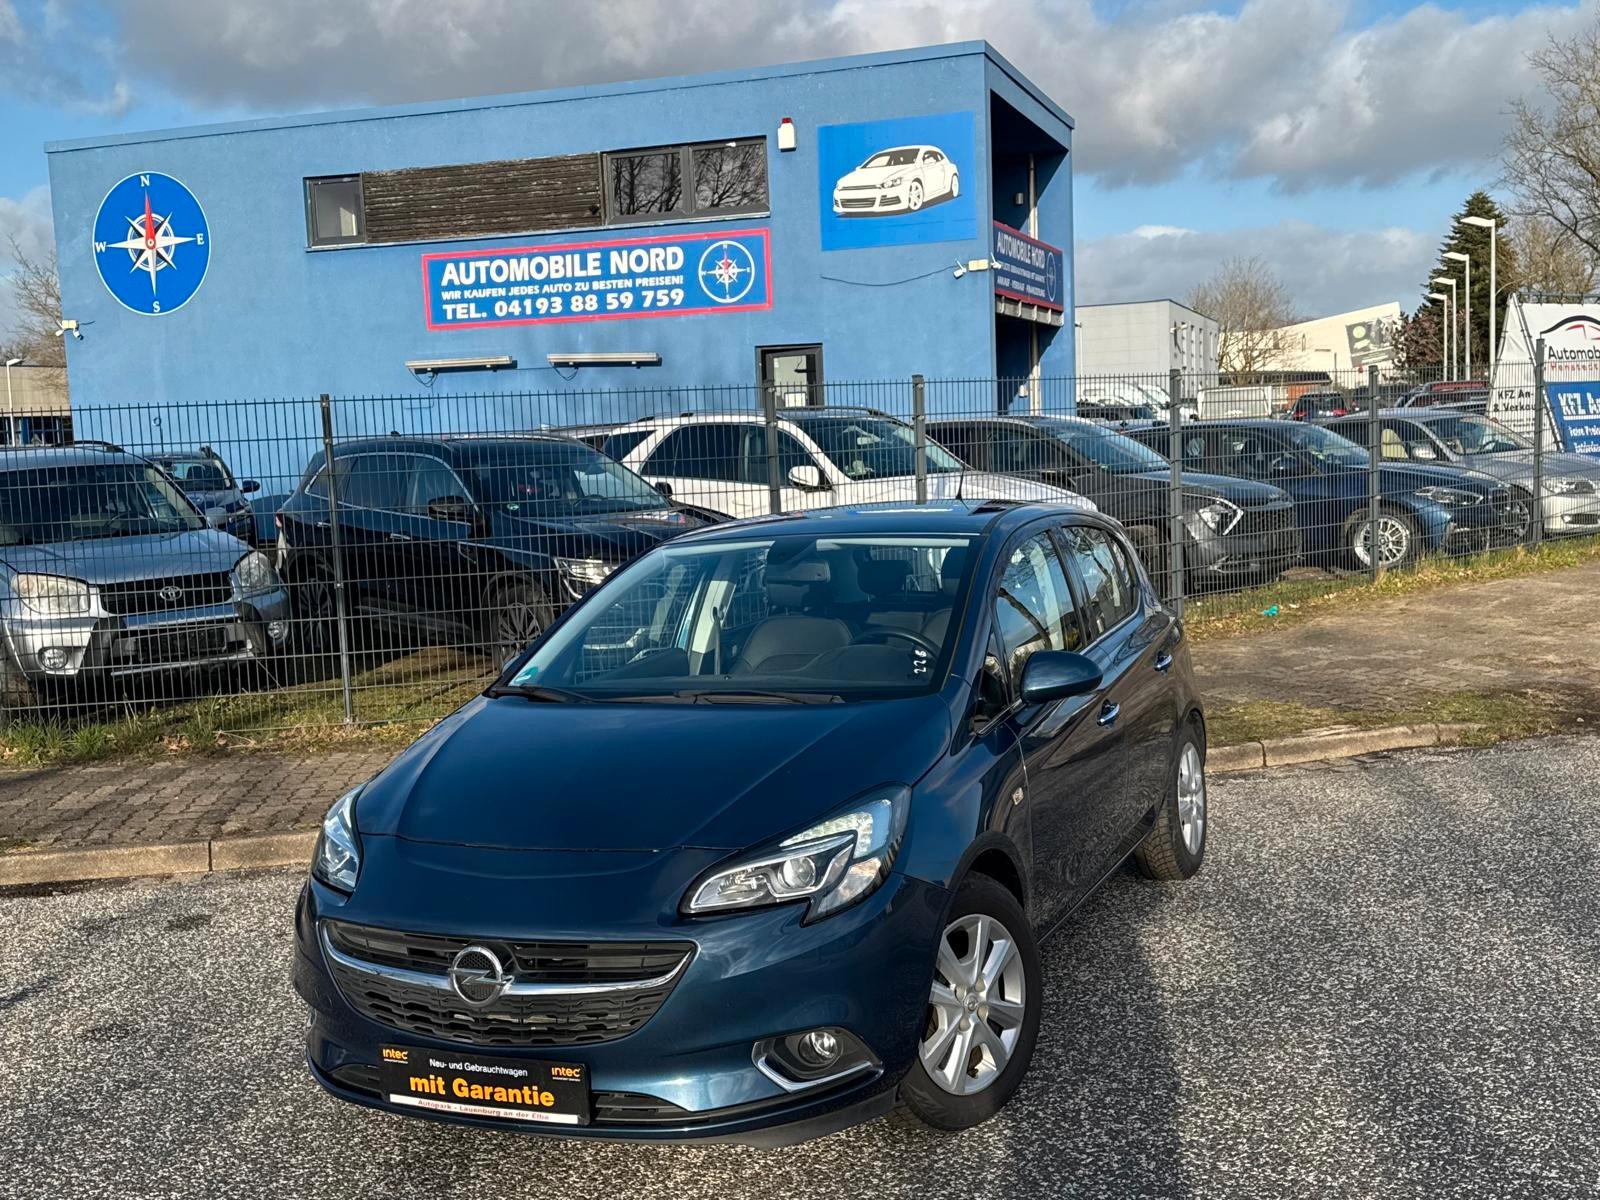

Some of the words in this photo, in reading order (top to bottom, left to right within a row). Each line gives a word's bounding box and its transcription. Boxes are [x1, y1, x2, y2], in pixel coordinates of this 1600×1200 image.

[140, 175, 150, 187] N
[95, 242, 107, 253] W
[196, 233, 204, 245] E
[997, 232, 1031, 264] AUTOMOBILE
[1031, 247, 1045, 269] NORD
[441, 252, 601, 286] AUTOMOBILE
[610, 246, 684, 275] NORD
[441, 290, 462, 301] WIR
[464, 287, 506, 298] KAUFEN
[508, 285, 540, 296] JEDES
[542, 282, 572, 293] AUTO
[574, 282, 589, 292] ZU
[592, 278, 632, 290] BESTEN
[635, 275, 684, 287] PREISEN!
[152, 301, 160, 313] S
[442, 303, 487, 320] TEL.
[494, 296, 562, 317] 04193
[570, 294, 598, 312] 88
[606, 291, 634, 310] 59
[641, 288, 684, 308] 759
[1498, 389, 1515, 400] KFZ
[1518, 389, 1534, 399] An-
[1557, 392, 1586, 415] KFZ
[1493, 403, 1499, 412] &
[1503, 402, 1537, 411] Verkau
[382, 1048, 409, 1060] intec
[429, 1058, 447, 1069] Neu-
[448, 1061, 463, 1071] und
[464, 1062, 528, 1078] Gebrauchtwagen
[551, 1067, 581, 1078] intec
[409, 1074, 446, 1096] mit
[452, 1077, 555, 1107] Garantie
[417, 1099, 451, 1111] Autopark
[459, 1105, 501, 1117] Lauenburg
[515, 1110, 529, 1119] der
